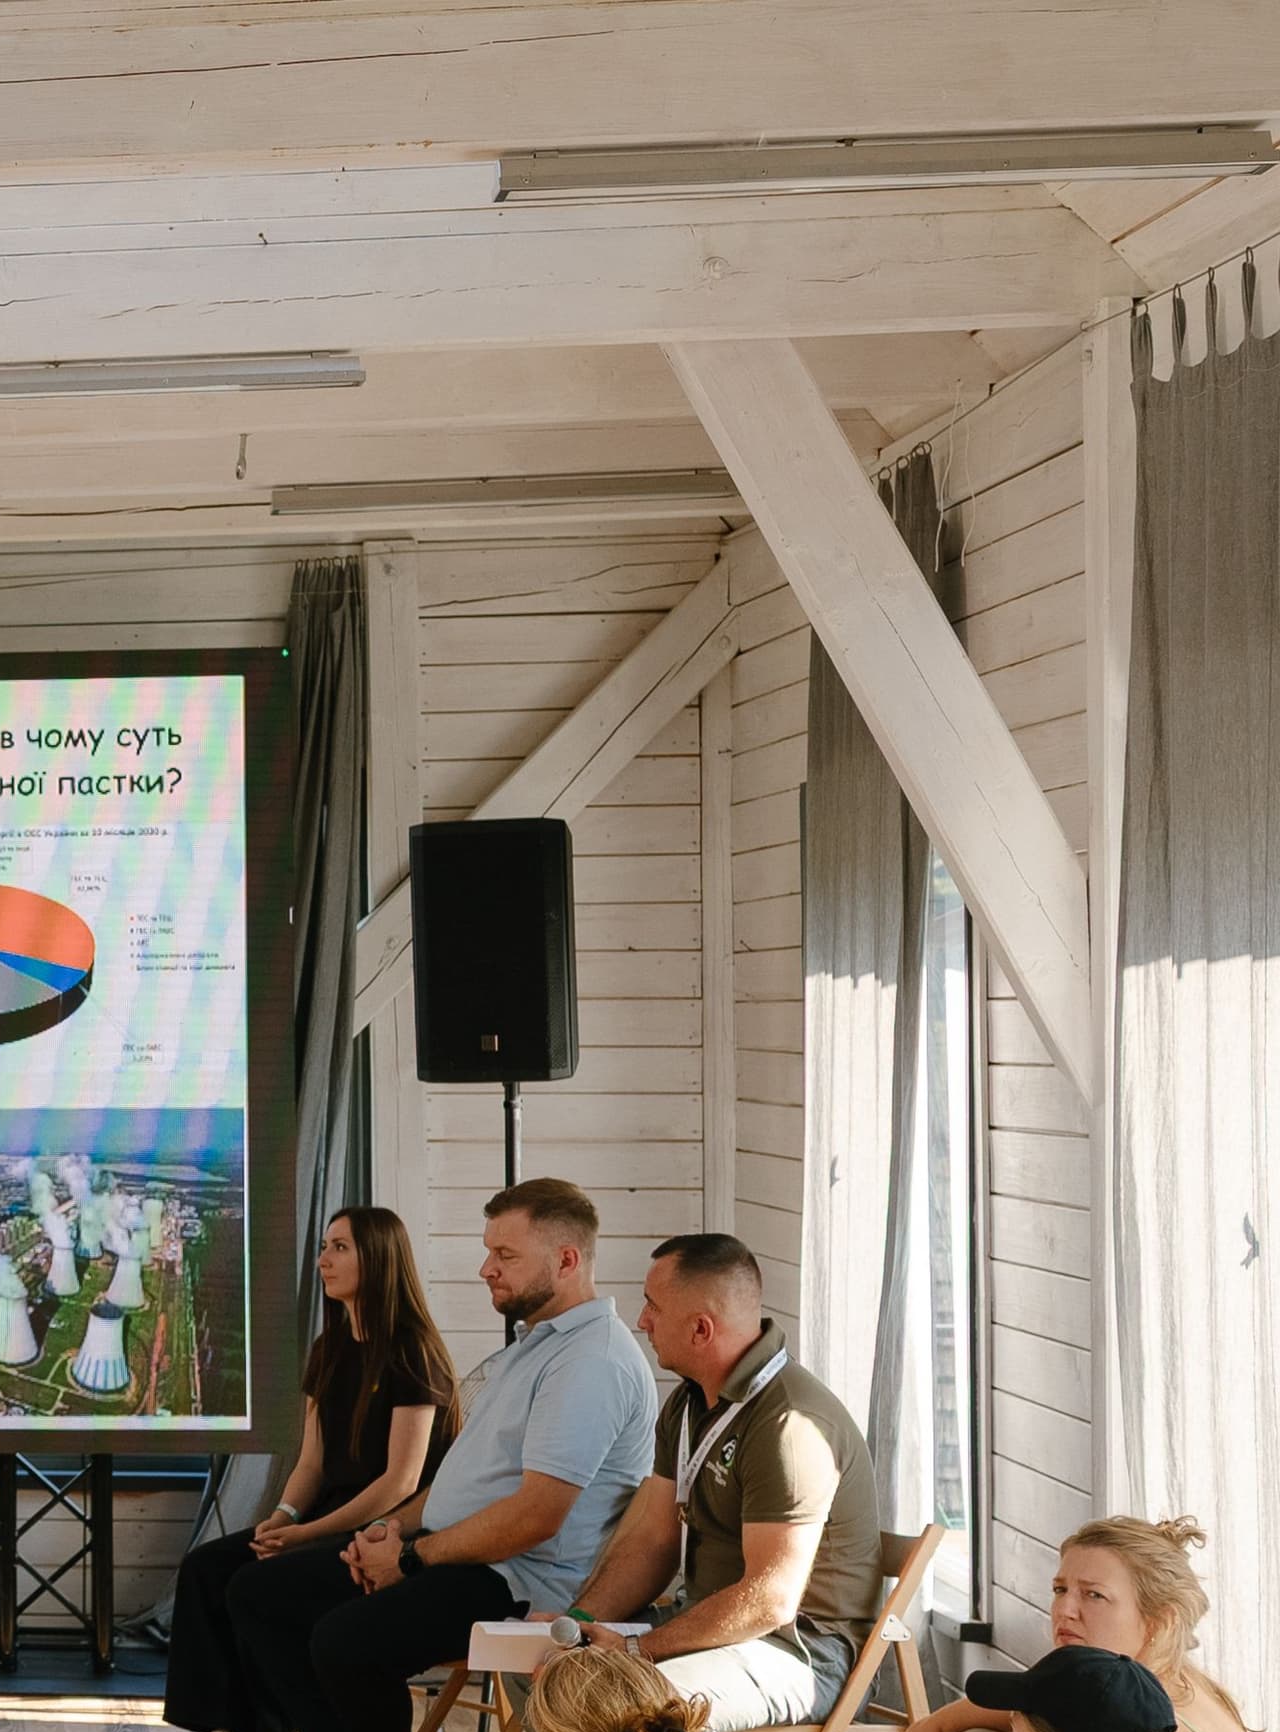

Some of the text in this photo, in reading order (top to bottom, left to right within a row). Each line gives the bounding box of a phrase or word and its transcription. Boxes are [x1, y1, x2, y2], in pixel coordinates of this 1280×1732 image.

[0, 732, 15, 749] в
[25, 729, 105, 758] чому
[116, 726, 183, 756] суть
[57, 766, 183, 796] пастки?
